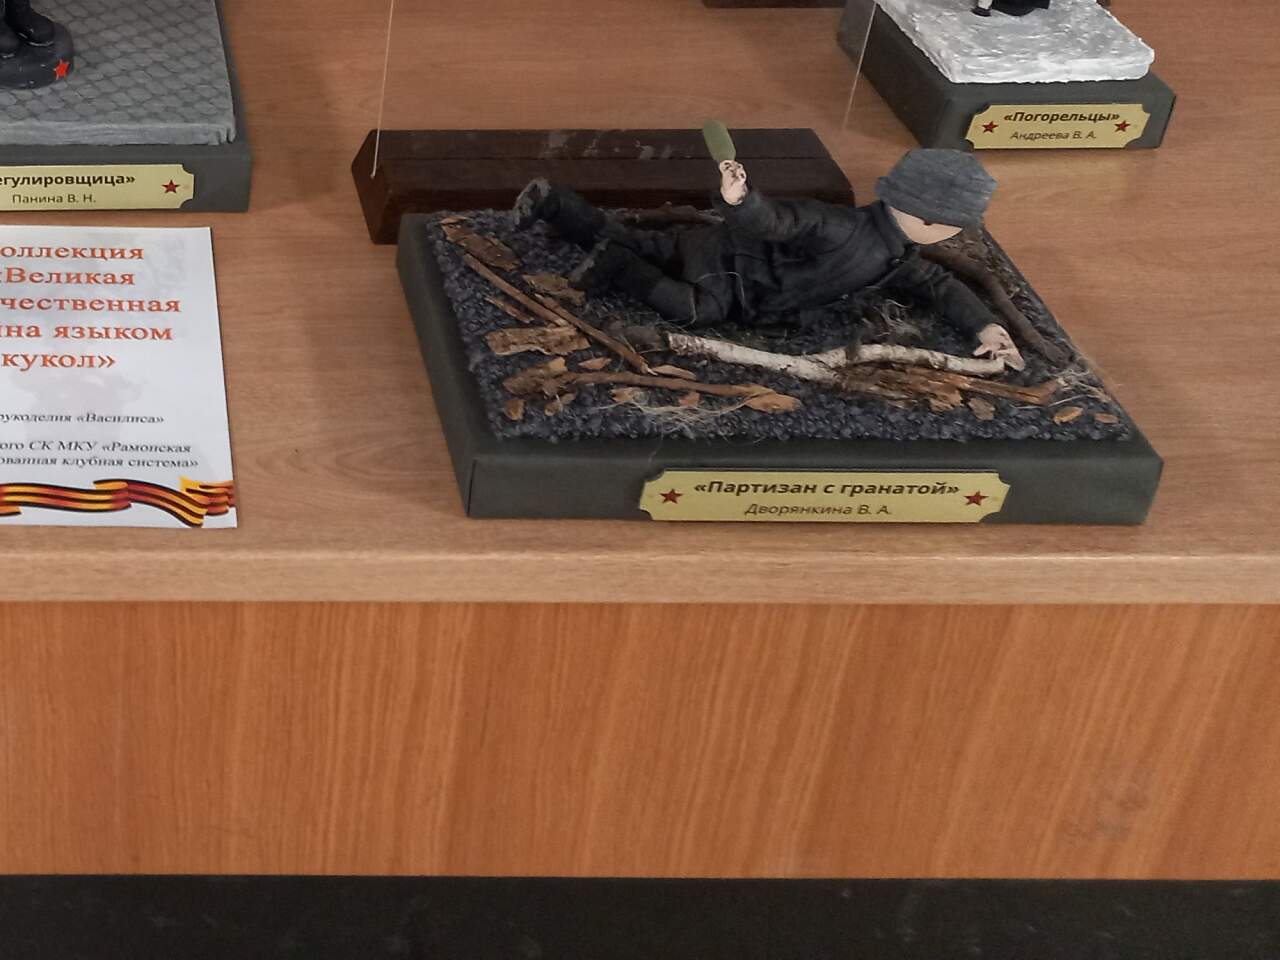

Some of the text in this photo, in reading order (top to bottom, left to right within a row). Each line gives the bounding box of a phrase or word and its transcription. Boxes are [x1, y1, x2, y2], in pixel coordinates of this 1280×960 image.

[1004, 111, 1121, 124] «Погорельцы»
[1010, 130, 1097, 141] Андреева В. А.
[12, 193, 97, 204] Панина В. Н.
[53, 326, 173, 340] языком
[1, 353, 116, 371] кукол»
[77, 412, 165, 424] «Василиса»
[29, 440, 54, 451] СК
[57, 440, 98, 451] МКУ
[101, 441, 191, 453] «Рамонская
[62, 457, 124, 468] клубная
[128, 459, 199, 468] система»
[693, 481, 960, 496] «Партизан с гранатой»
[743, 503, 893, 517] Дворянкина В. А.
